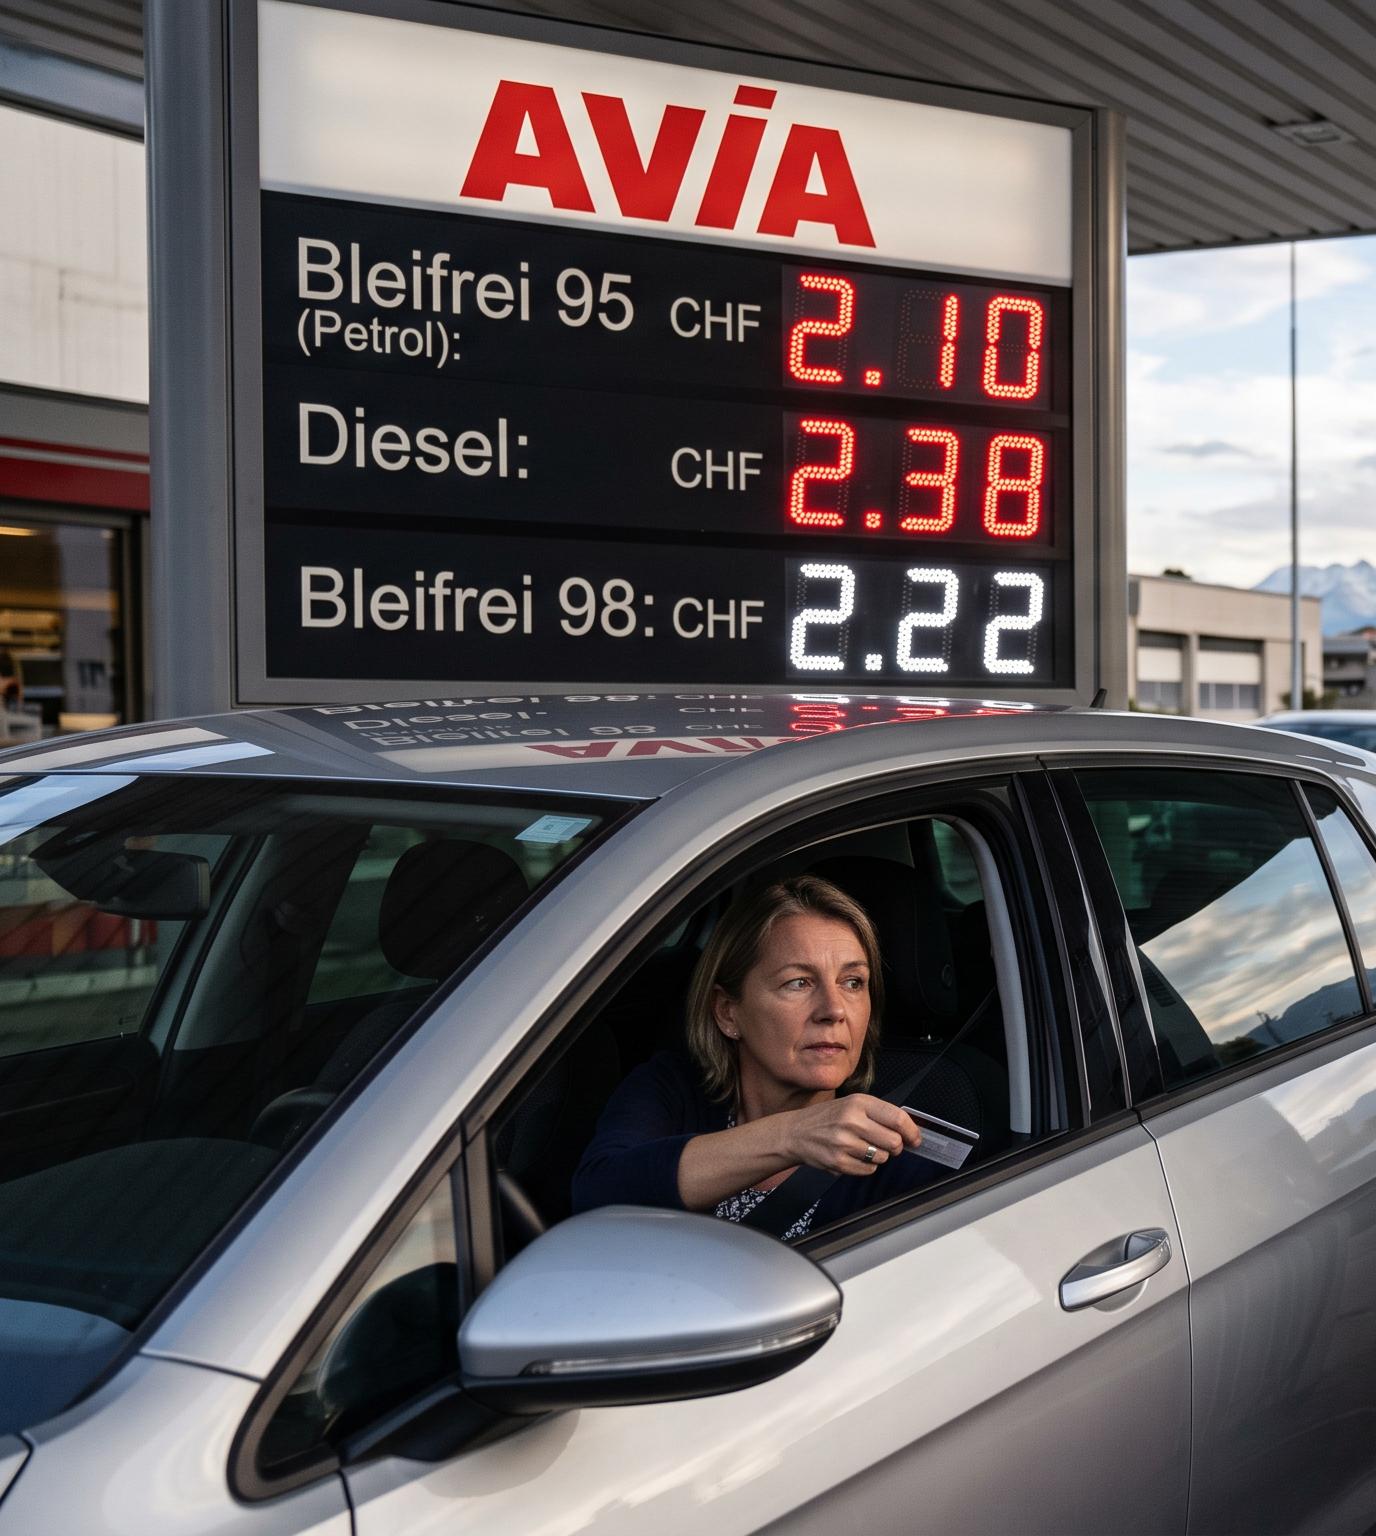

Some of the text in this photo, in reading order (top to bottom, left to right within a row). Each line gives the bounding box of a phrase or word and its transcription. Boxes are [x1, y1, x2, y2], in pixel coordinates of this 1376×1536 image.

[298, 237, 1044, 400] Bleifrei 95 CHF 2.10
[298, 309, 460, 366] (Petrol):
[300, 403, 1044, 538] Diesel: CHF 2.38
[301, 564, 1044, 674] Bleifrei 98: CHF 2.22
